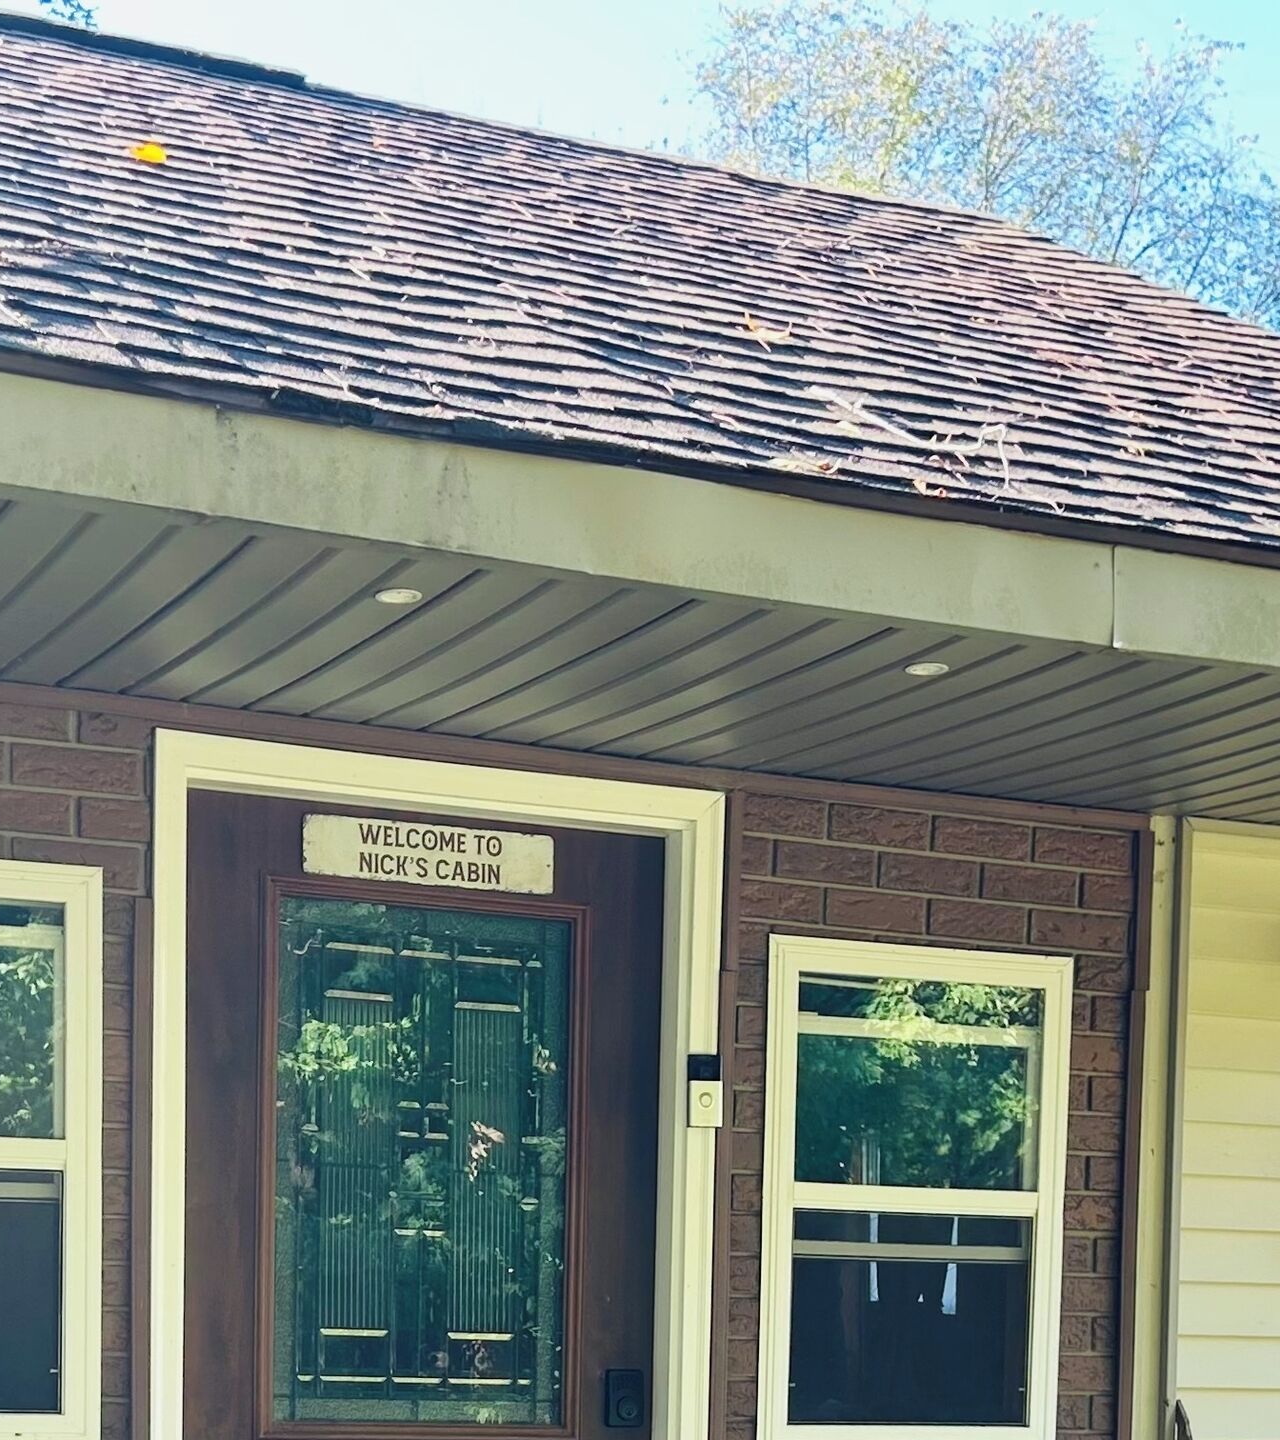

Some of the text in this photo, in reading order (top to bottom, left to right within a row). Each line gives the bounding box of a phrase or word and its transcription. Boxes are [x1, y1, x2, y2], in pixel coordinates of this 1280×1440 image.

[358, 823, 502, 857] WELCOME TO
[359, 852, 501, 885] NICK'S CABIN
